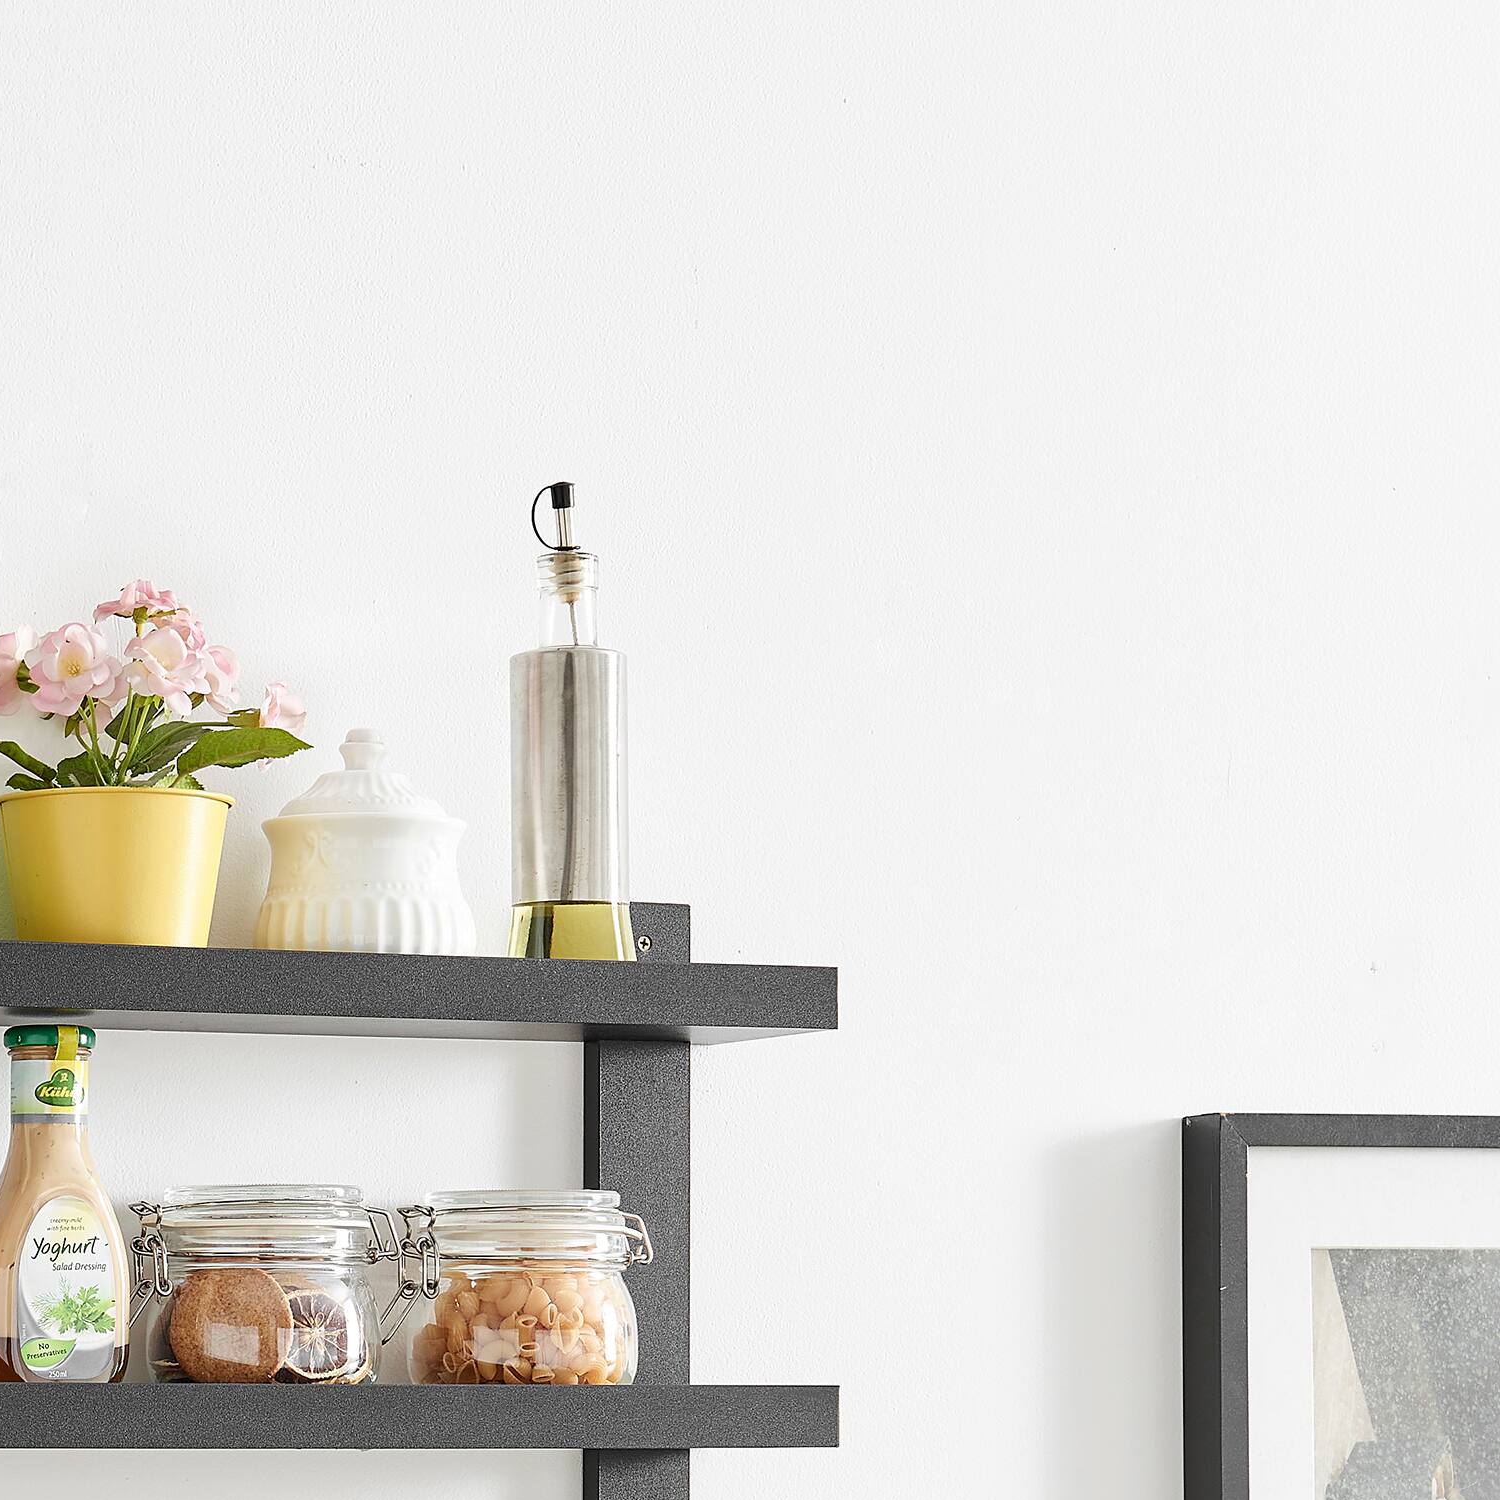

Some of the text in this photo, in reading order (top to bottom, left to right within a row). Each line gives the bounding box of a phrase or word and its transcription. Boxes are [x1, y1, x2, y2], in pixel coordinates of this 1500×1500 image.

[40, 1086, 74, 1097] Küh
[31, 1236, 100, 1262] Yoghurt
[52, 1262, 107, 1272] Salad Dressing
[27, 1349, 67, 1360] Preservatives
